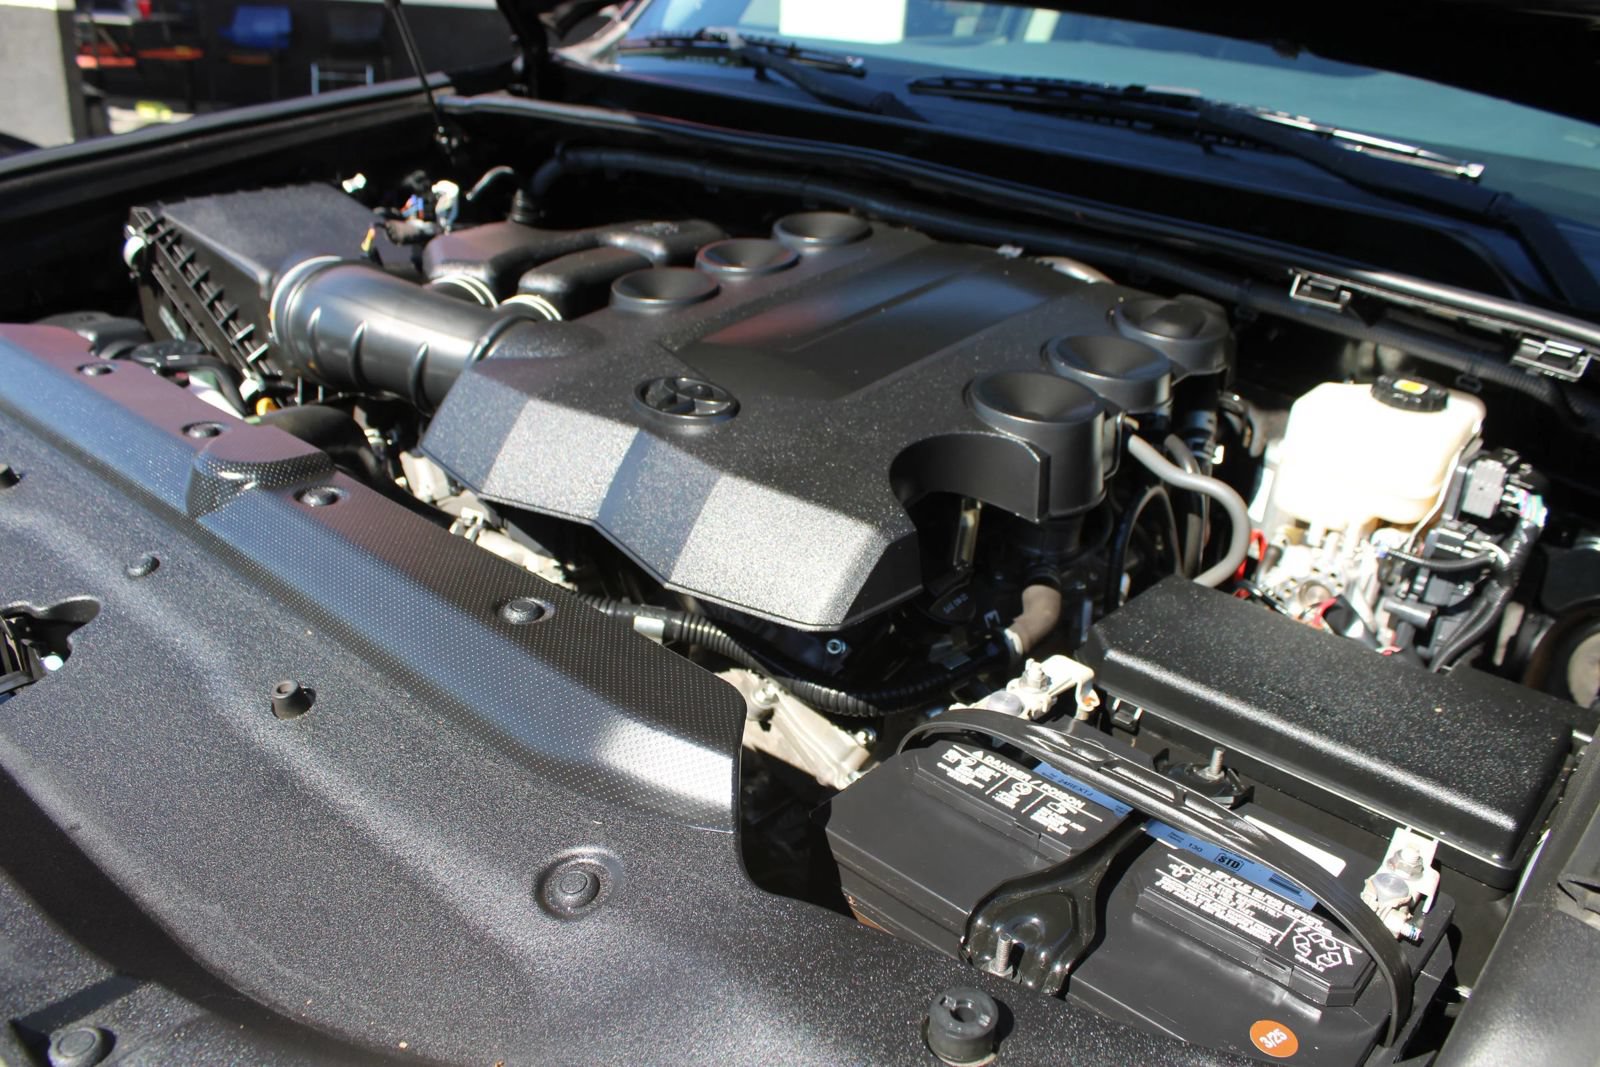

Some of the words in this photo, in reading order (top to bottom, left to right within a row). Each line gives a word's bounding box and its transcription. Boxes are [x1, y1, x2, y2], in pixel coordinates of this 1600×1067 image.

[984, 754, 1032, 781] DANGER
[1040, 783, 1086, 808] POISON
[1218, 855, 1240, 869] STD
